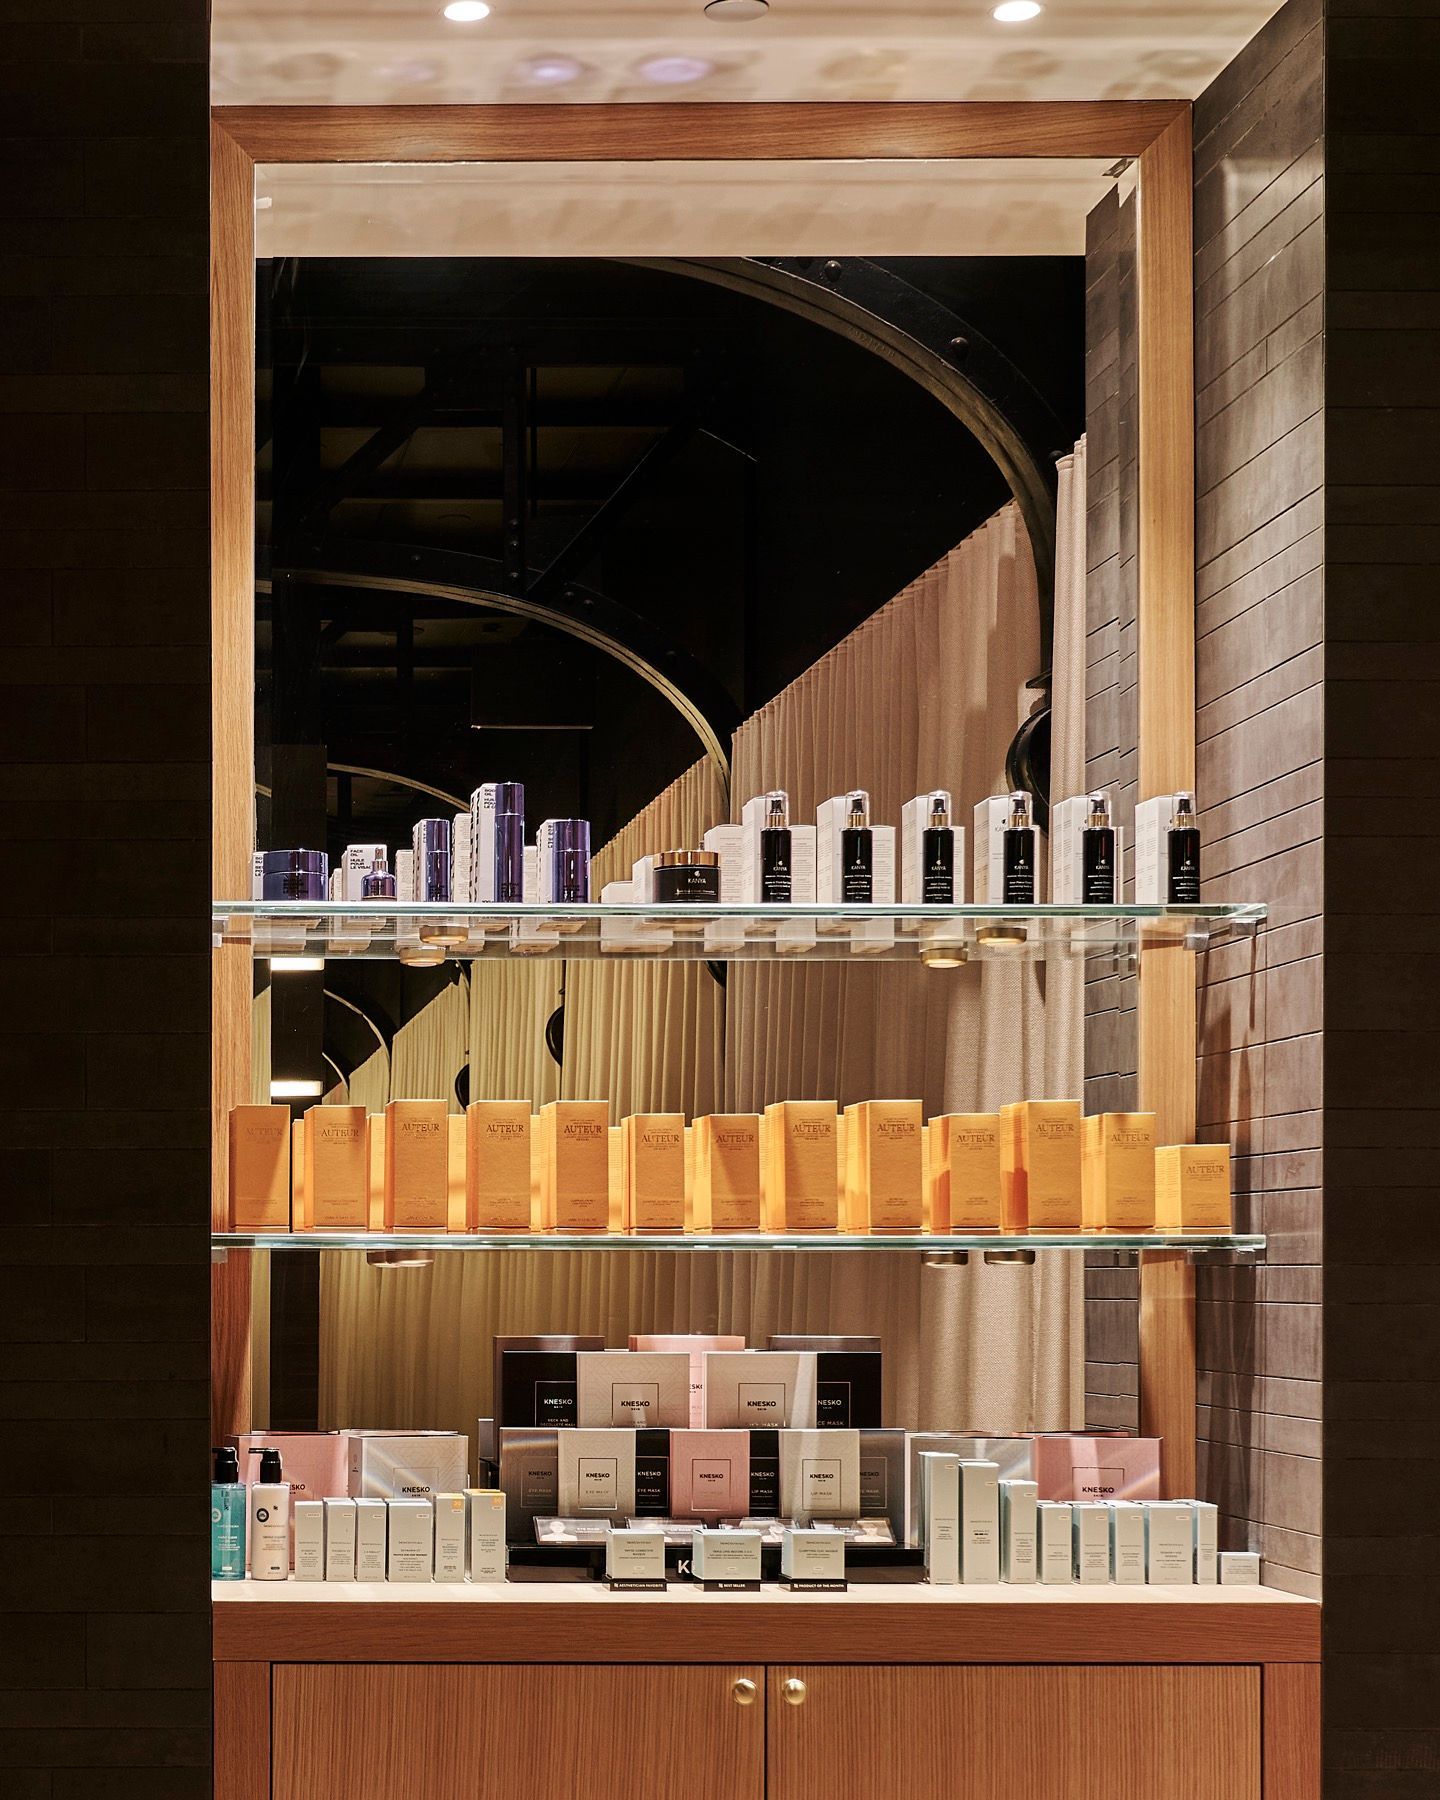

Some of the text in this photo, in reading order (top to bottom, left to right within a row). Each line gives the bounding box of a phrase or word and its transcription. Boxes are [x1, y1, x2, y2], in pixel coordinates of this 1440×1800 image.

[401, 1123, 440, 1132] AUTEUR
[486, 1124, 524, 1133] AUTEUR
[563, 1124, 602, 1134] AUTEUR
[792, 1124, 831, 1133] AUTEUR
[876, 1123, 915, 1132] AUTEUR
[1035, 1123, 1074, 1133] AUTEUR
[320, 1128, 359, 1137] AUTEUR
[641, 1134, 680, 1143] AUTEUR
[716, 1135, 755, 1144] AUTEUR
[956, 1134, 995, 1143] AUTEUR
[1111, 1133, 1150, 1143] AUTEUR
[1185, 1165, 1225, 1174] AUTEUR
